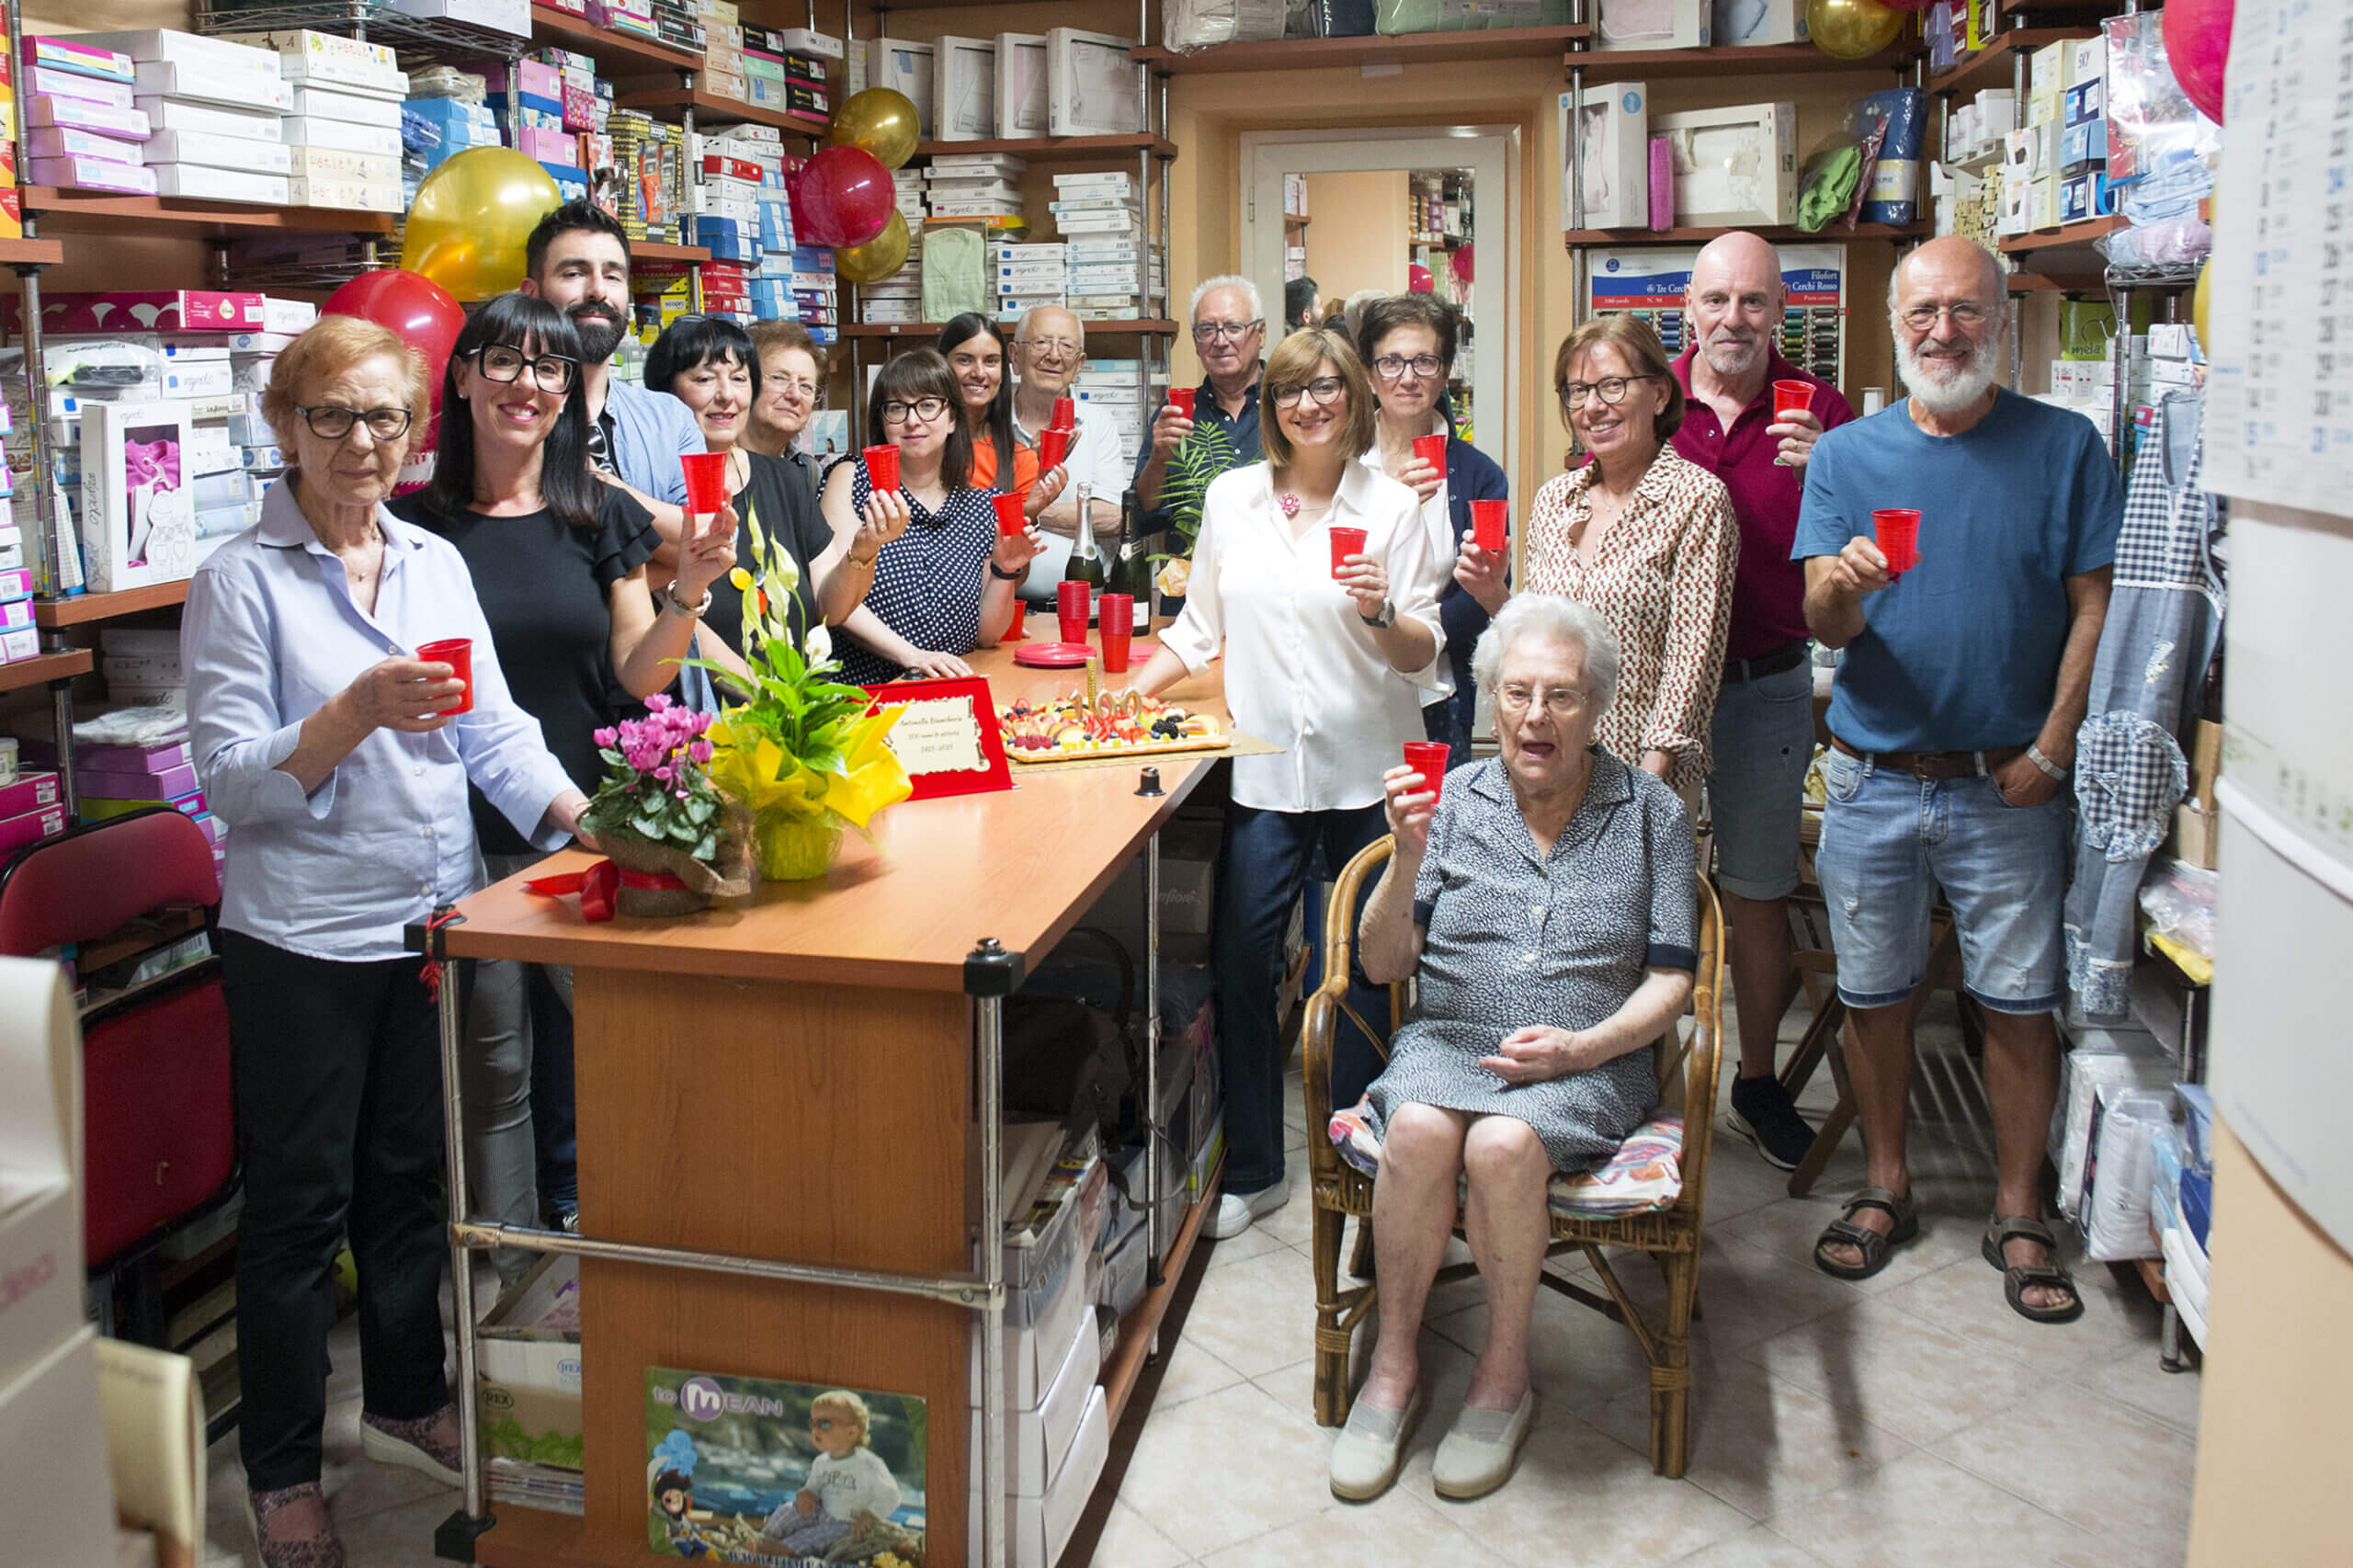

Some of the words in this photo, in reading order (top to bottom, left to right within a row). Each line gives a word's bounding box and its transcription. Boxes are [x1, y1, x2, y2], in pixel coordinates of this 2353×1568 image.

[1668, 283, 1686, 294] Cerc
[1792, 281, 1815, 292] Cerchi
[1068, 685, 1143, 722] 100
[653, 1384, 678, 1406] to
